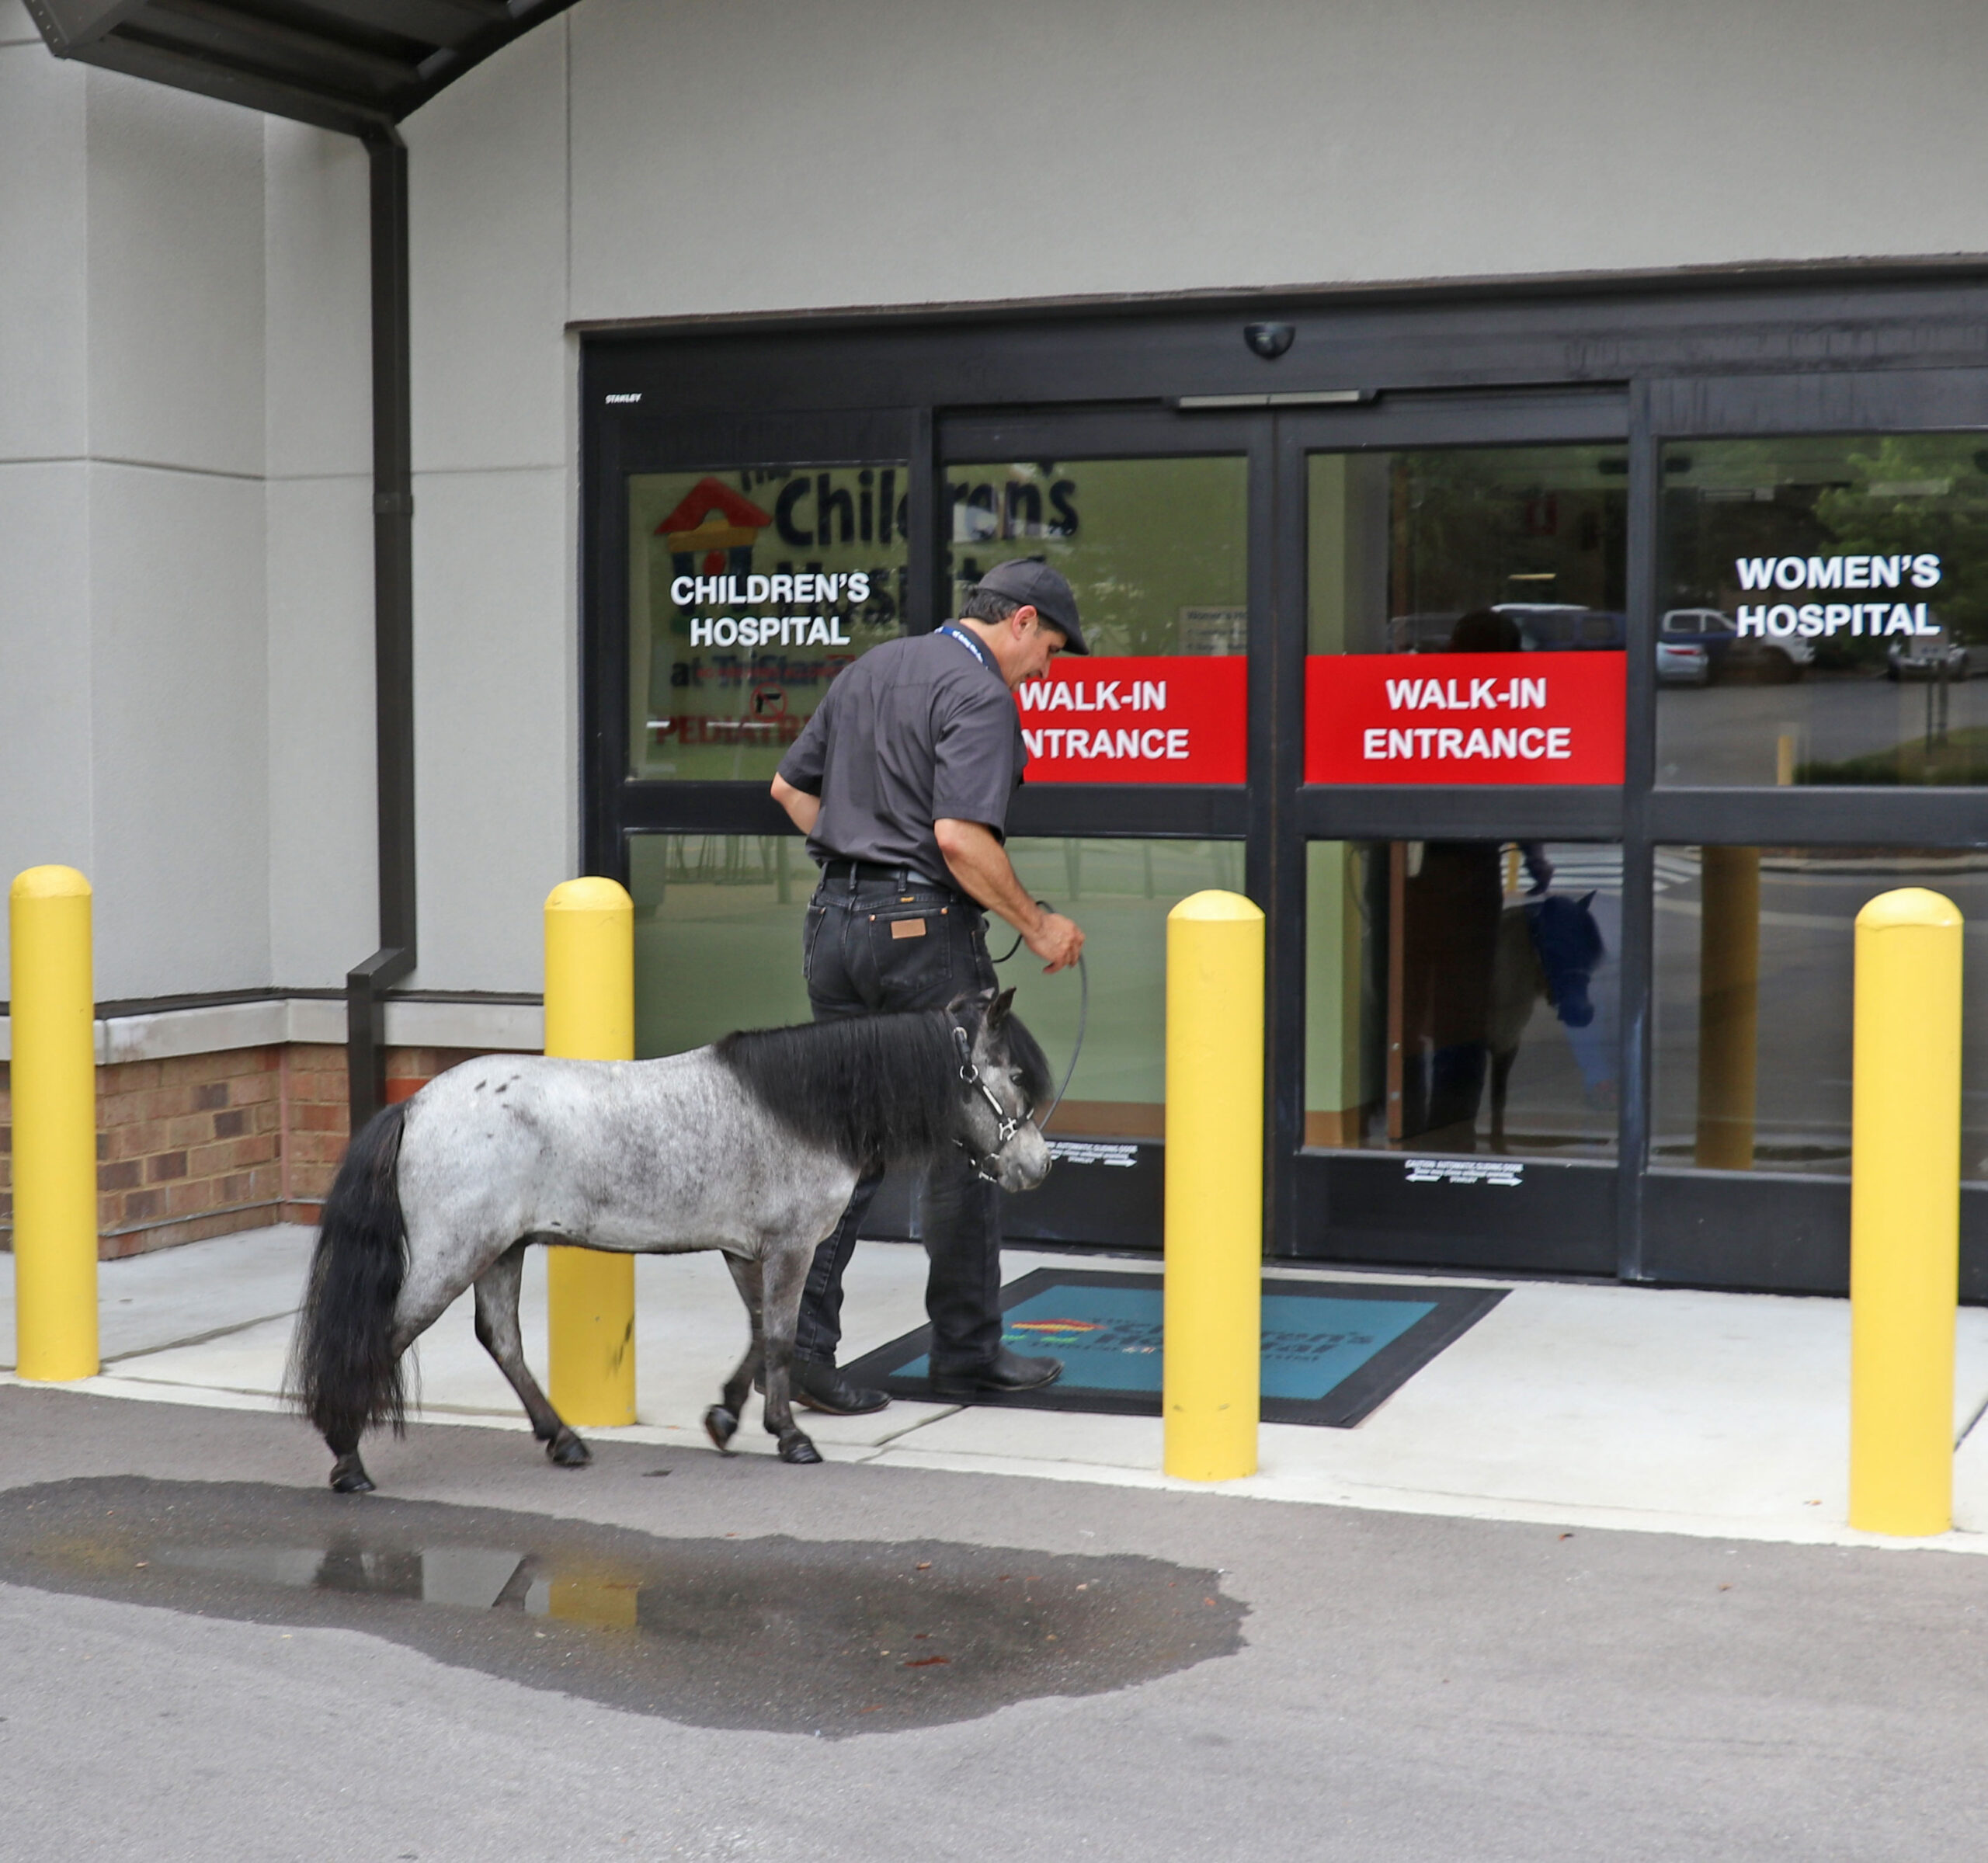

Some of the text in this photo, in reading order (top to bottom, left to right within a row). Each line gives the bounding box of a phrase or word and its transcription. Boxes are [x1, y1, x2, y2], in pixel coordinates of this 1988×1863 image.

[1736, 554, 1941, 590] WOMEN'S
[670, 572, 871, 606] CHILDREN'S
[690, 616, 851, 647] HOSPITAL
[1736, 602, 1941, 638] HOSPITAL
[1019, 681, 1166, 711] WALK-IN
[1385, 676, 1546, 711] WALK-IN
[1021, 728, 1190, 759] NTRANCE
[1364, 727, 1572, 759] ENTRANCE
